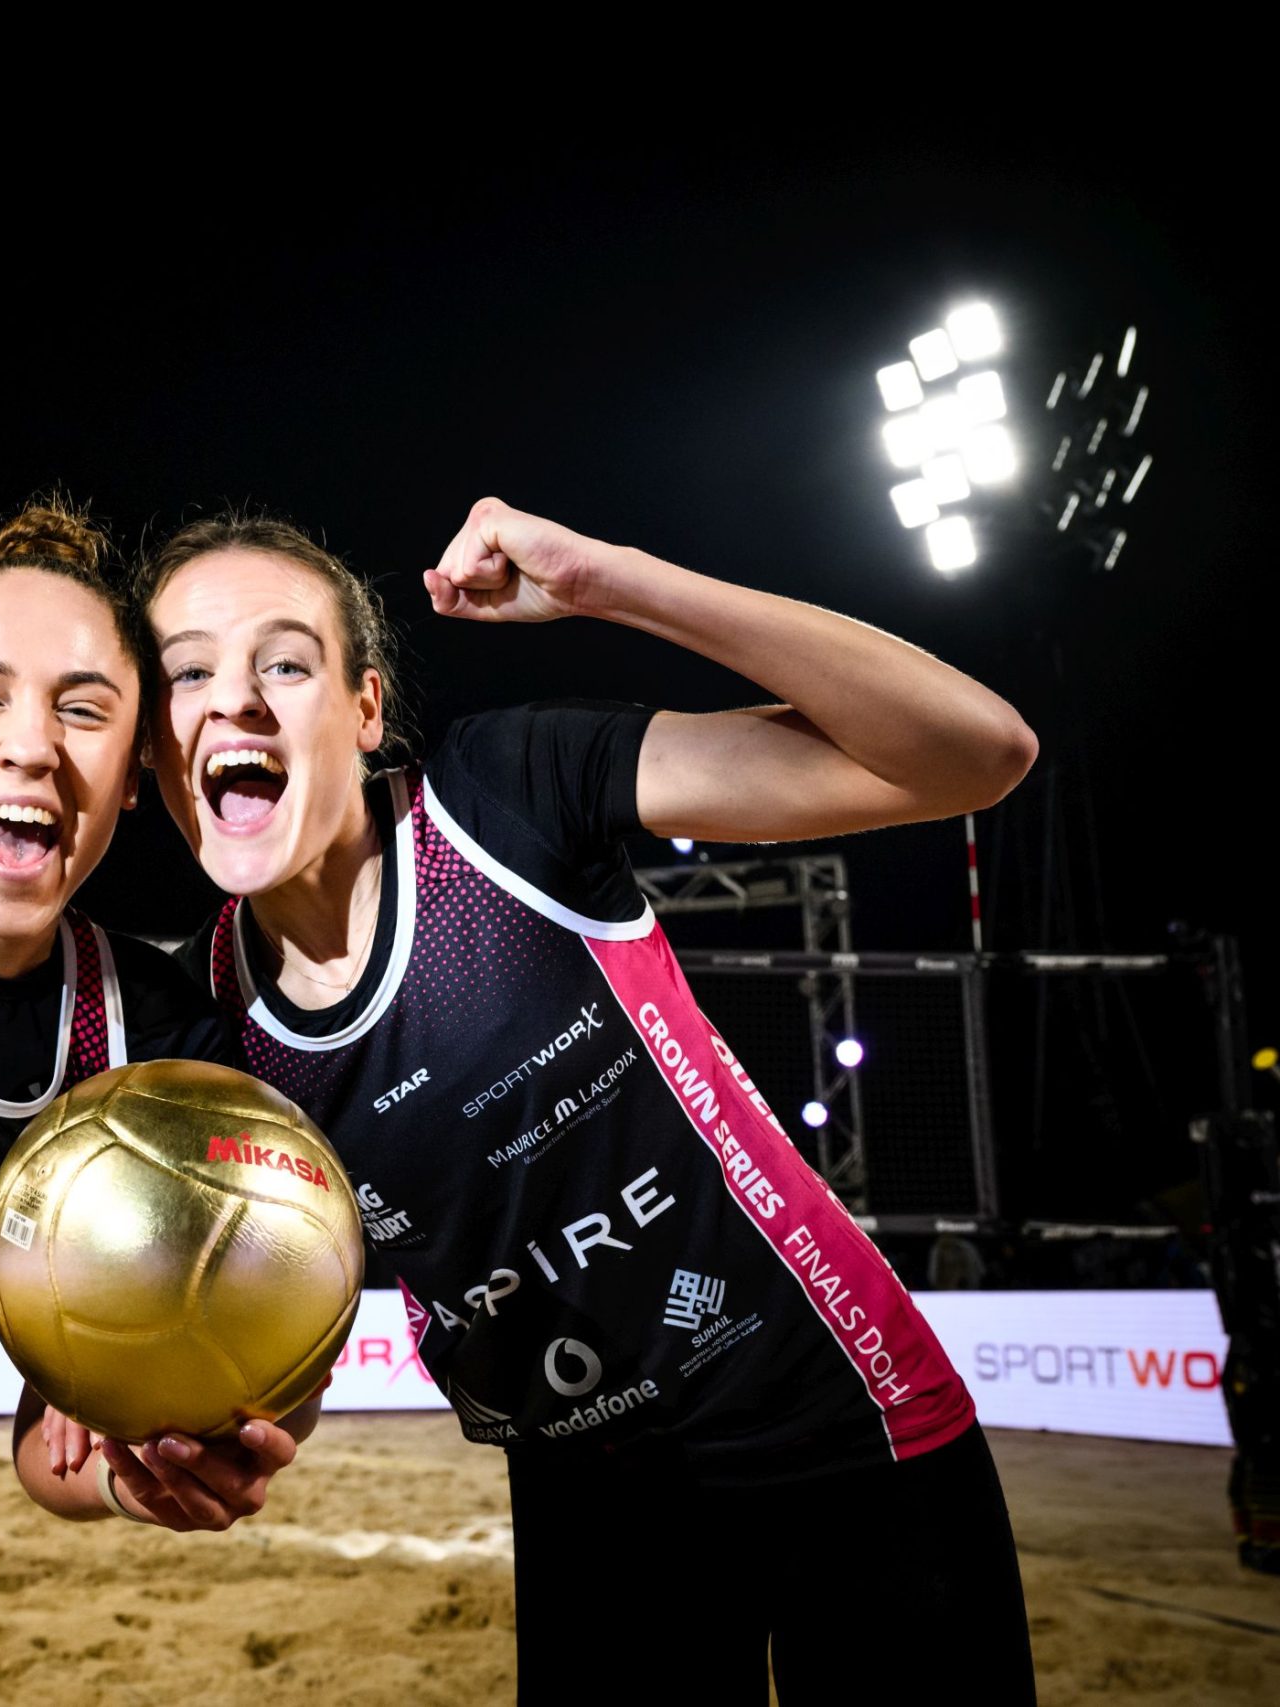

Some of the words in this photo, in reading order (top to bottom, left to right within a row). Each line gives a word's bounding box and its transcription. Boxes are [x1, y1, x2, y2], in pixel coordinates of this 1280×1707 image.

[373, 1067, 432, 1114] STAR
[487, 1119, 553, 1169] MAURICE
[579, 1047, 638, 1104] LACROIX
[638, 1002, 720, 1124] CROWN
[713, 1119, 786, 1219] SERIES
[783, 1225, 867, 1331] FINALS
[364, 1210, 414, 1242] OURT
[711, 1328, 737, 1348] HOLDING
[736, 1312, 759, 1330] GROUP
[975, 1343, 1221, 1391] SPORTWO
[539, 1378, 660, 1438] vodafone
